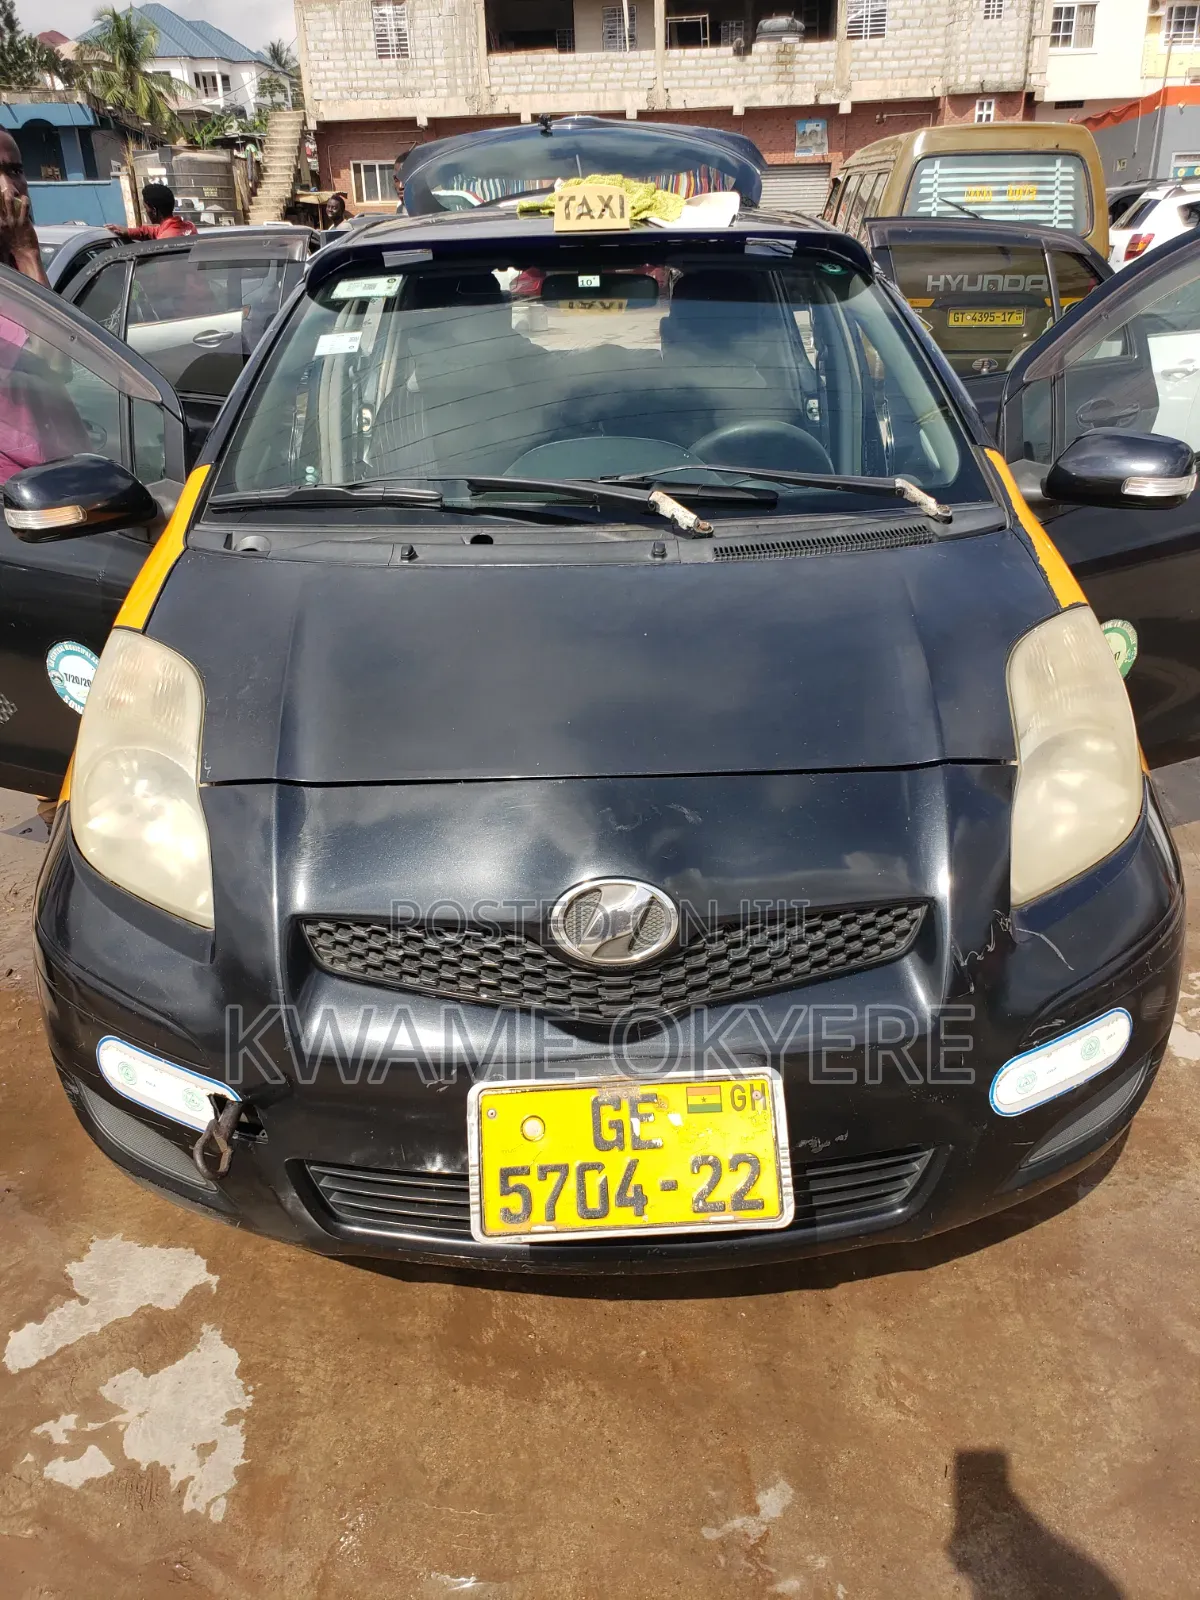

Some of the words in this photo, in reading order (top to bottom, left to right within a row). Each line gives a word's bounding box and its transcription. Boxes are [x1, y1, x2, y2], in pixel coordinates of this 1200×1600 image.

[558, 194, 625, 220] TAXI
[926, 274, 1049, 292] HYUNDA
[953, 312, 966, 322] GT
[971, 311, 1014, 322] 4395-17
[730, 1083, 768, 1111] GH
[591, 1092, 664, 1152] GE
[499, 1153, 765, 1224] 5704-22
